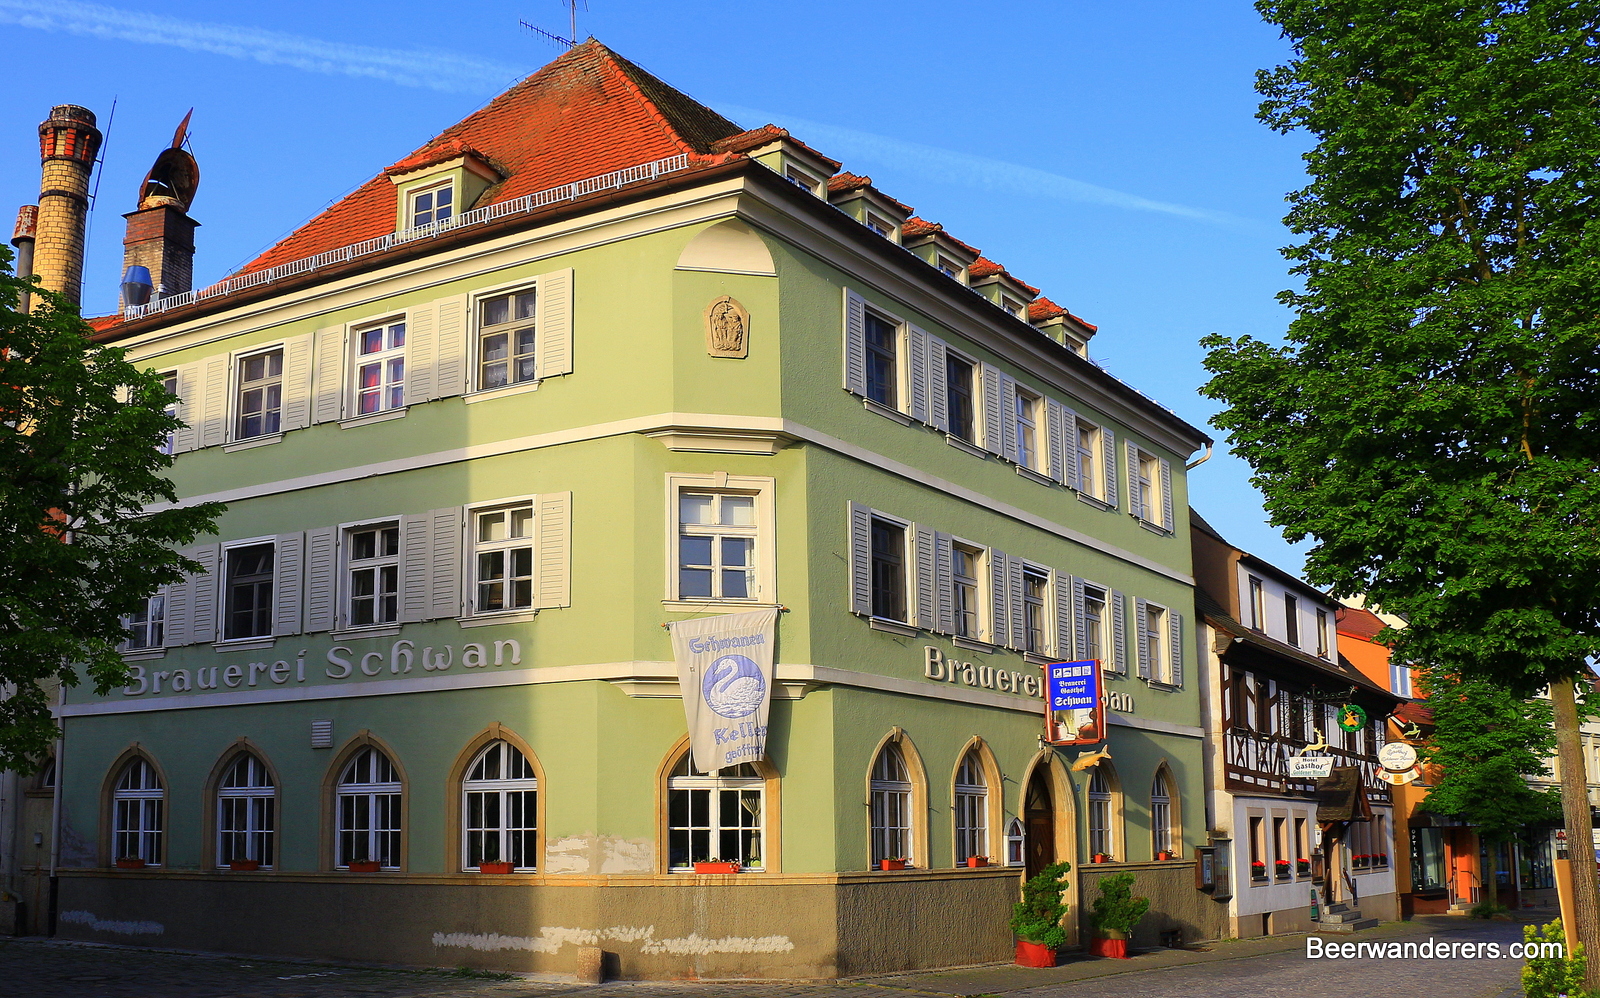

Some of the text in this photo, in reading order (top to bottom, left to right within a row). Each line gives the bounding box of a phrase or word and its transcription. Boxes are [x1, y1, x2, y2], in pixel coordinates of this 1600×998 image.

[688, 633, 765, 654] Schwanen
[123, 639, 522, 696] Brauerei Schwan
[924, 645, 1044, 698] Brauerei
[1059, 679, 1087, 687] Brauerei
[1060, 686, 1086, 695] Gasthof
[1054, 696, 1093, 708] Schwan
[1295, 762, 1324, 771] Gasthof
